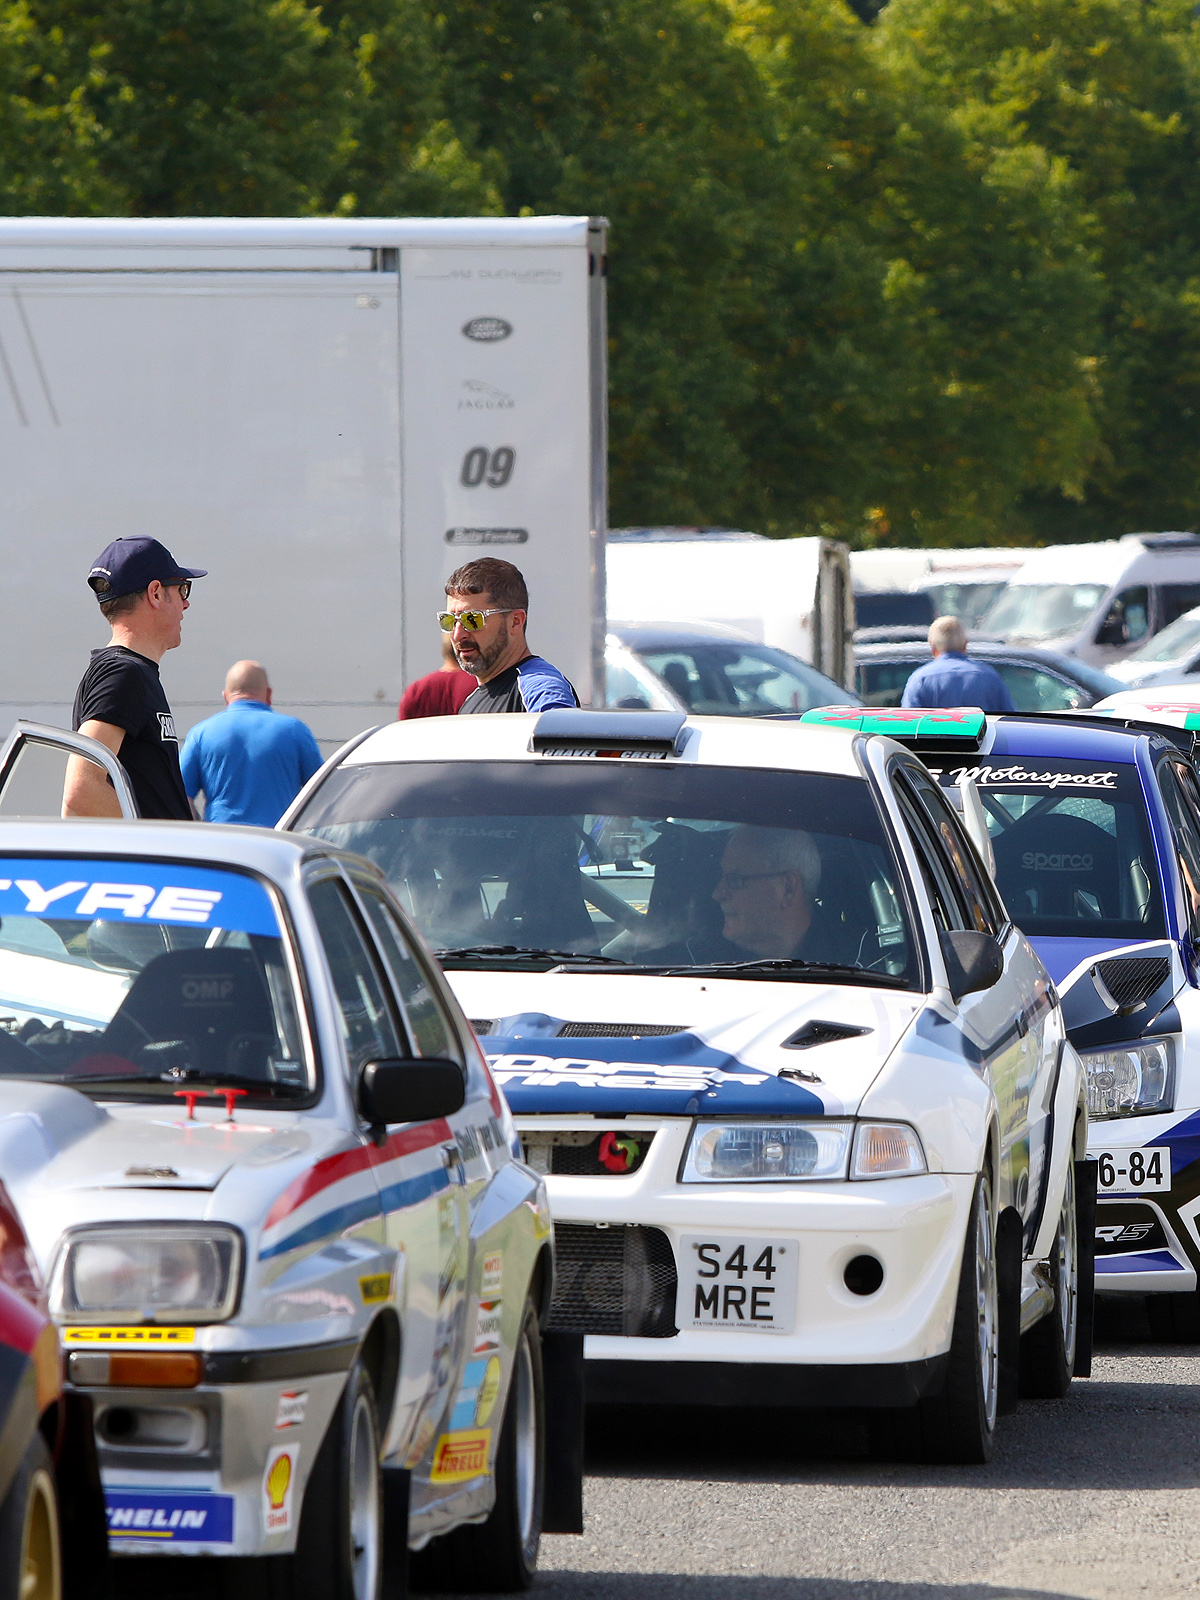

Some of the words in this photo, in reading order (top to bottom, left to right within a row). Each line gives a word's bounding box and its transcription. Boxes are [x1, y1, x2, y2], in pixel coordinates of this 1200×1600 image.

[460, 446, 516, 488] 09
[543, 749, 598, 757] GRAVEL
[620, 751, 666, 759] CREW
[949, 765, 1119, 789] Motorsport
[1022, 851, 1094, 871] sparco
[183, 981, 234, 999] OMP
[1086, 1151, 1164, 1188] 6-84
[1094, 1222, 1155, 1243] R5
[697, 1243, 777, 1281] S44
[694, 1284, 776, 1321] MRE
[438, 1440, 487, 1475] PIRELLI
[267, 1511, 289, 1528] Shell
